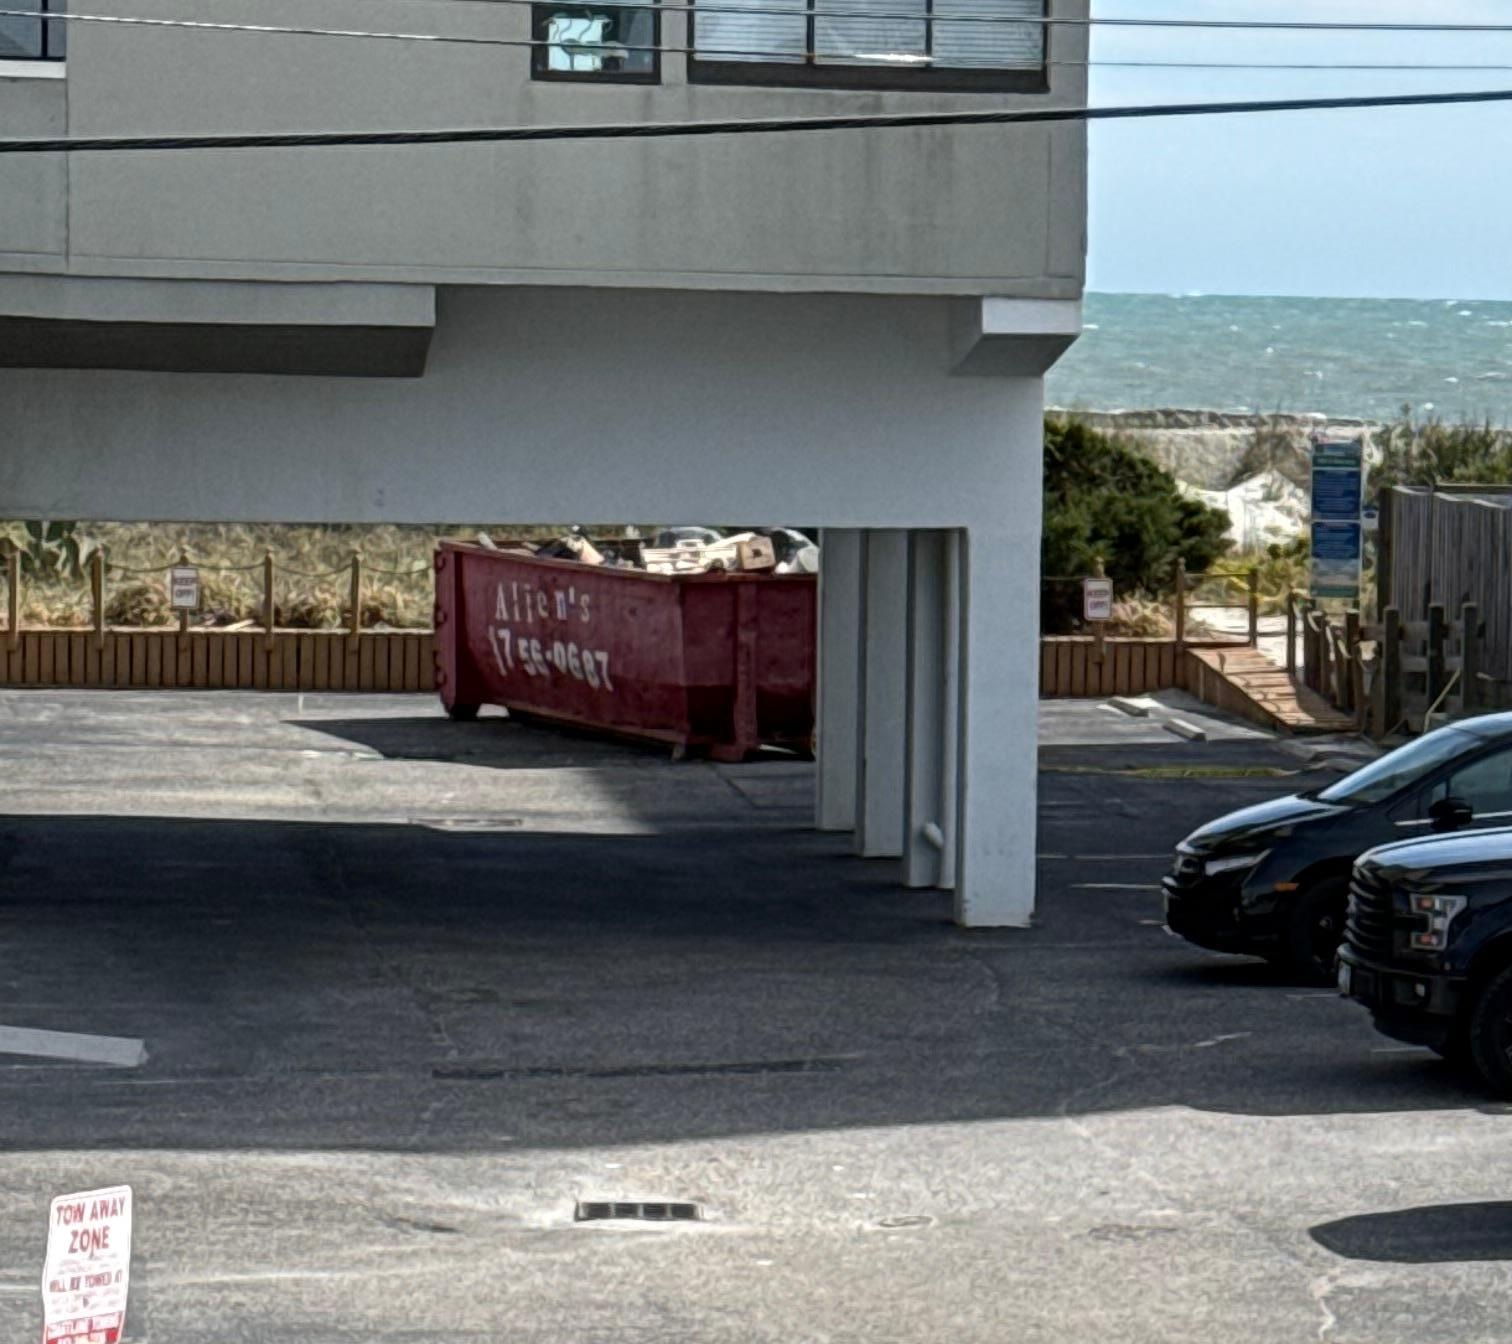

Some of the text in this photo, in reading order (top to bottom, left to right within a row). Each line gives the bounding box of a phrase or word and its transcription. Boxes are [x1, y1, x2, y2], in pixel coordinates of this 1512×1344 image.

[56, 1196, 125, 1226] TOW AWAY
[68, 1226, 110, 1254] ZONE
